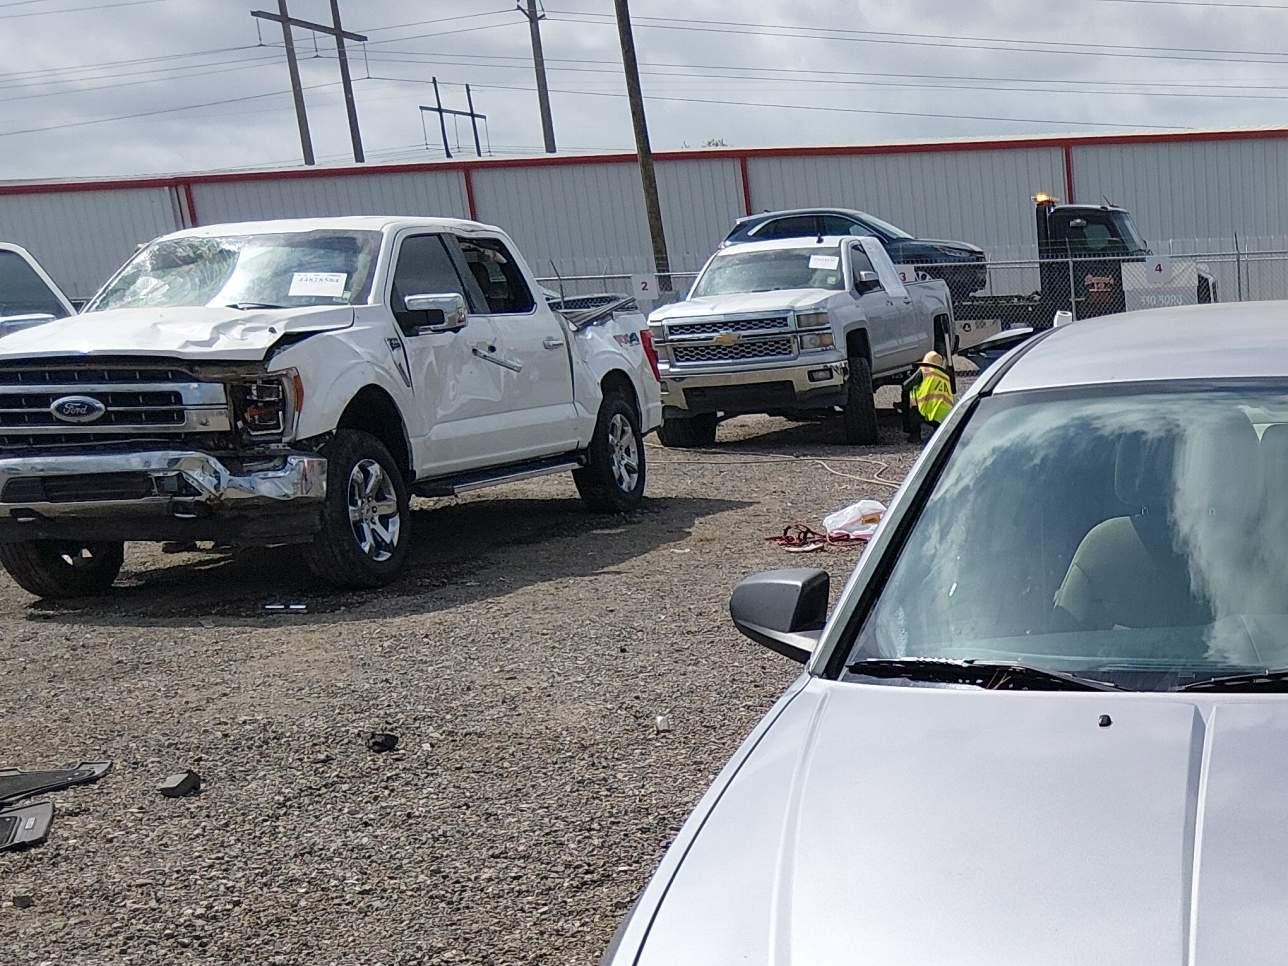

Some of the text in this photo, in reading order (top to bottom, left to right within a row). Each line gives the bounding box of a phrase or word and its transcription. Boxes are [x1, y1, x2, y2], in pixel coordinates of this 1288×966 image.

[1155, 263, 1163, 273] 4
[899, 272, 906, 281] 3
[641, 281, 649, 291] 2
[62, 402, 89, 415] Ford
